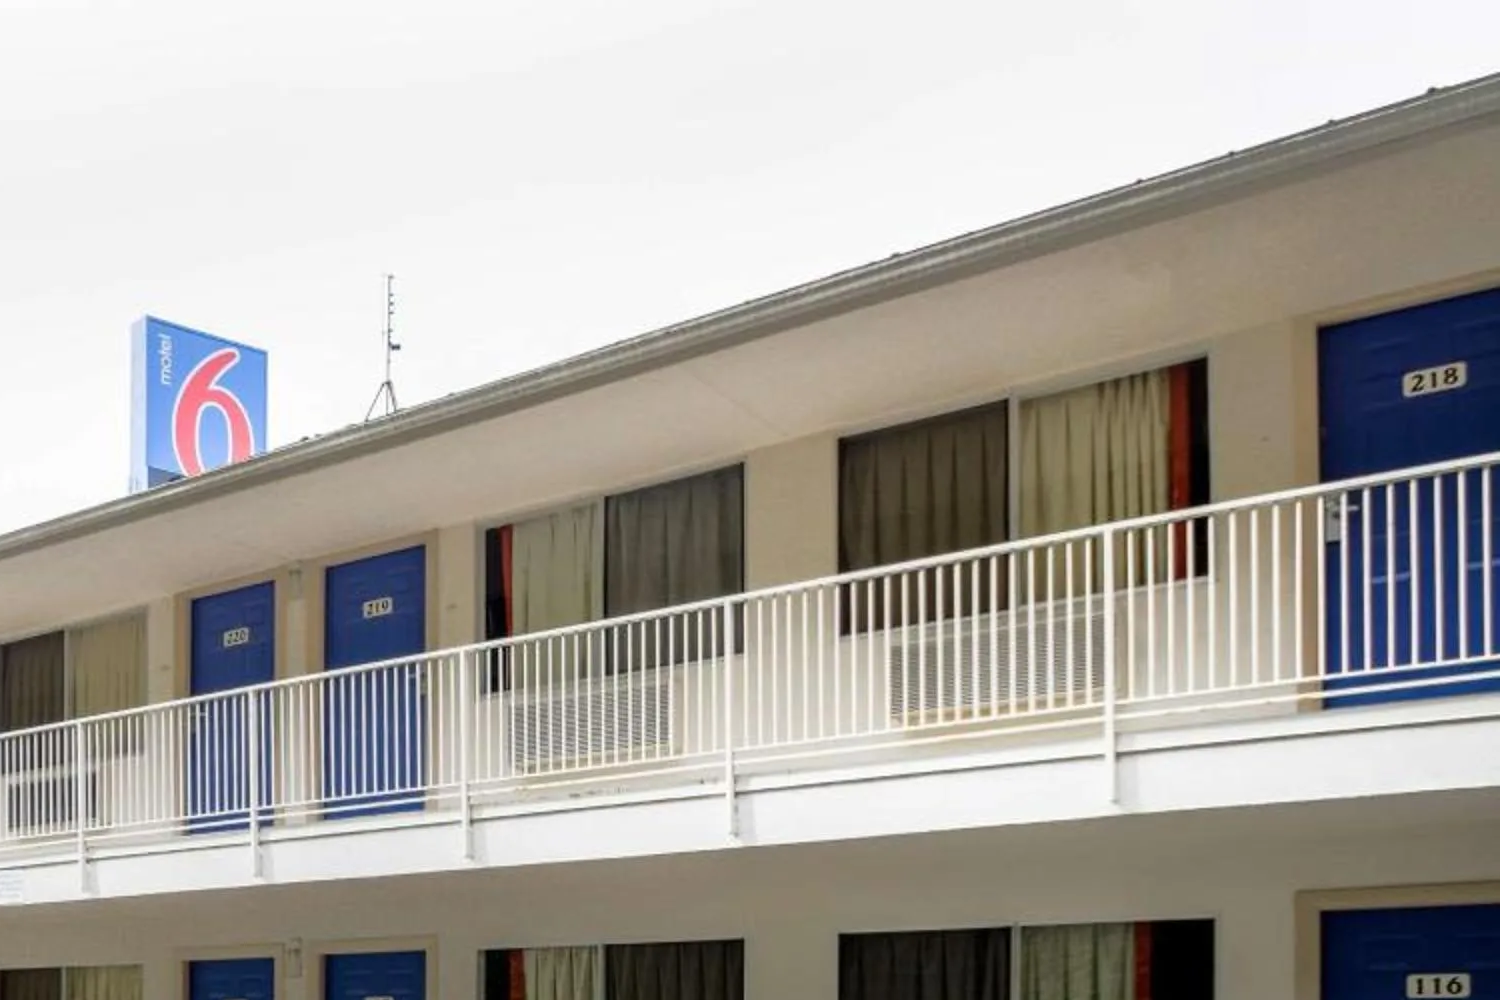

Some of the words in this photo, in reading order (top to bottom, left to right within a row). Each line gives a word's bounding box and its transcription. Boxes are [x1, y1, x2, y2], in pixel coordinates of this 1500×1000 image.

[158, 333, 173, 385] motel
[1411, 367, 1459, 392] 218
[172, 347, 255, 477] 6
[1416, 976, 1463, 995] 116
